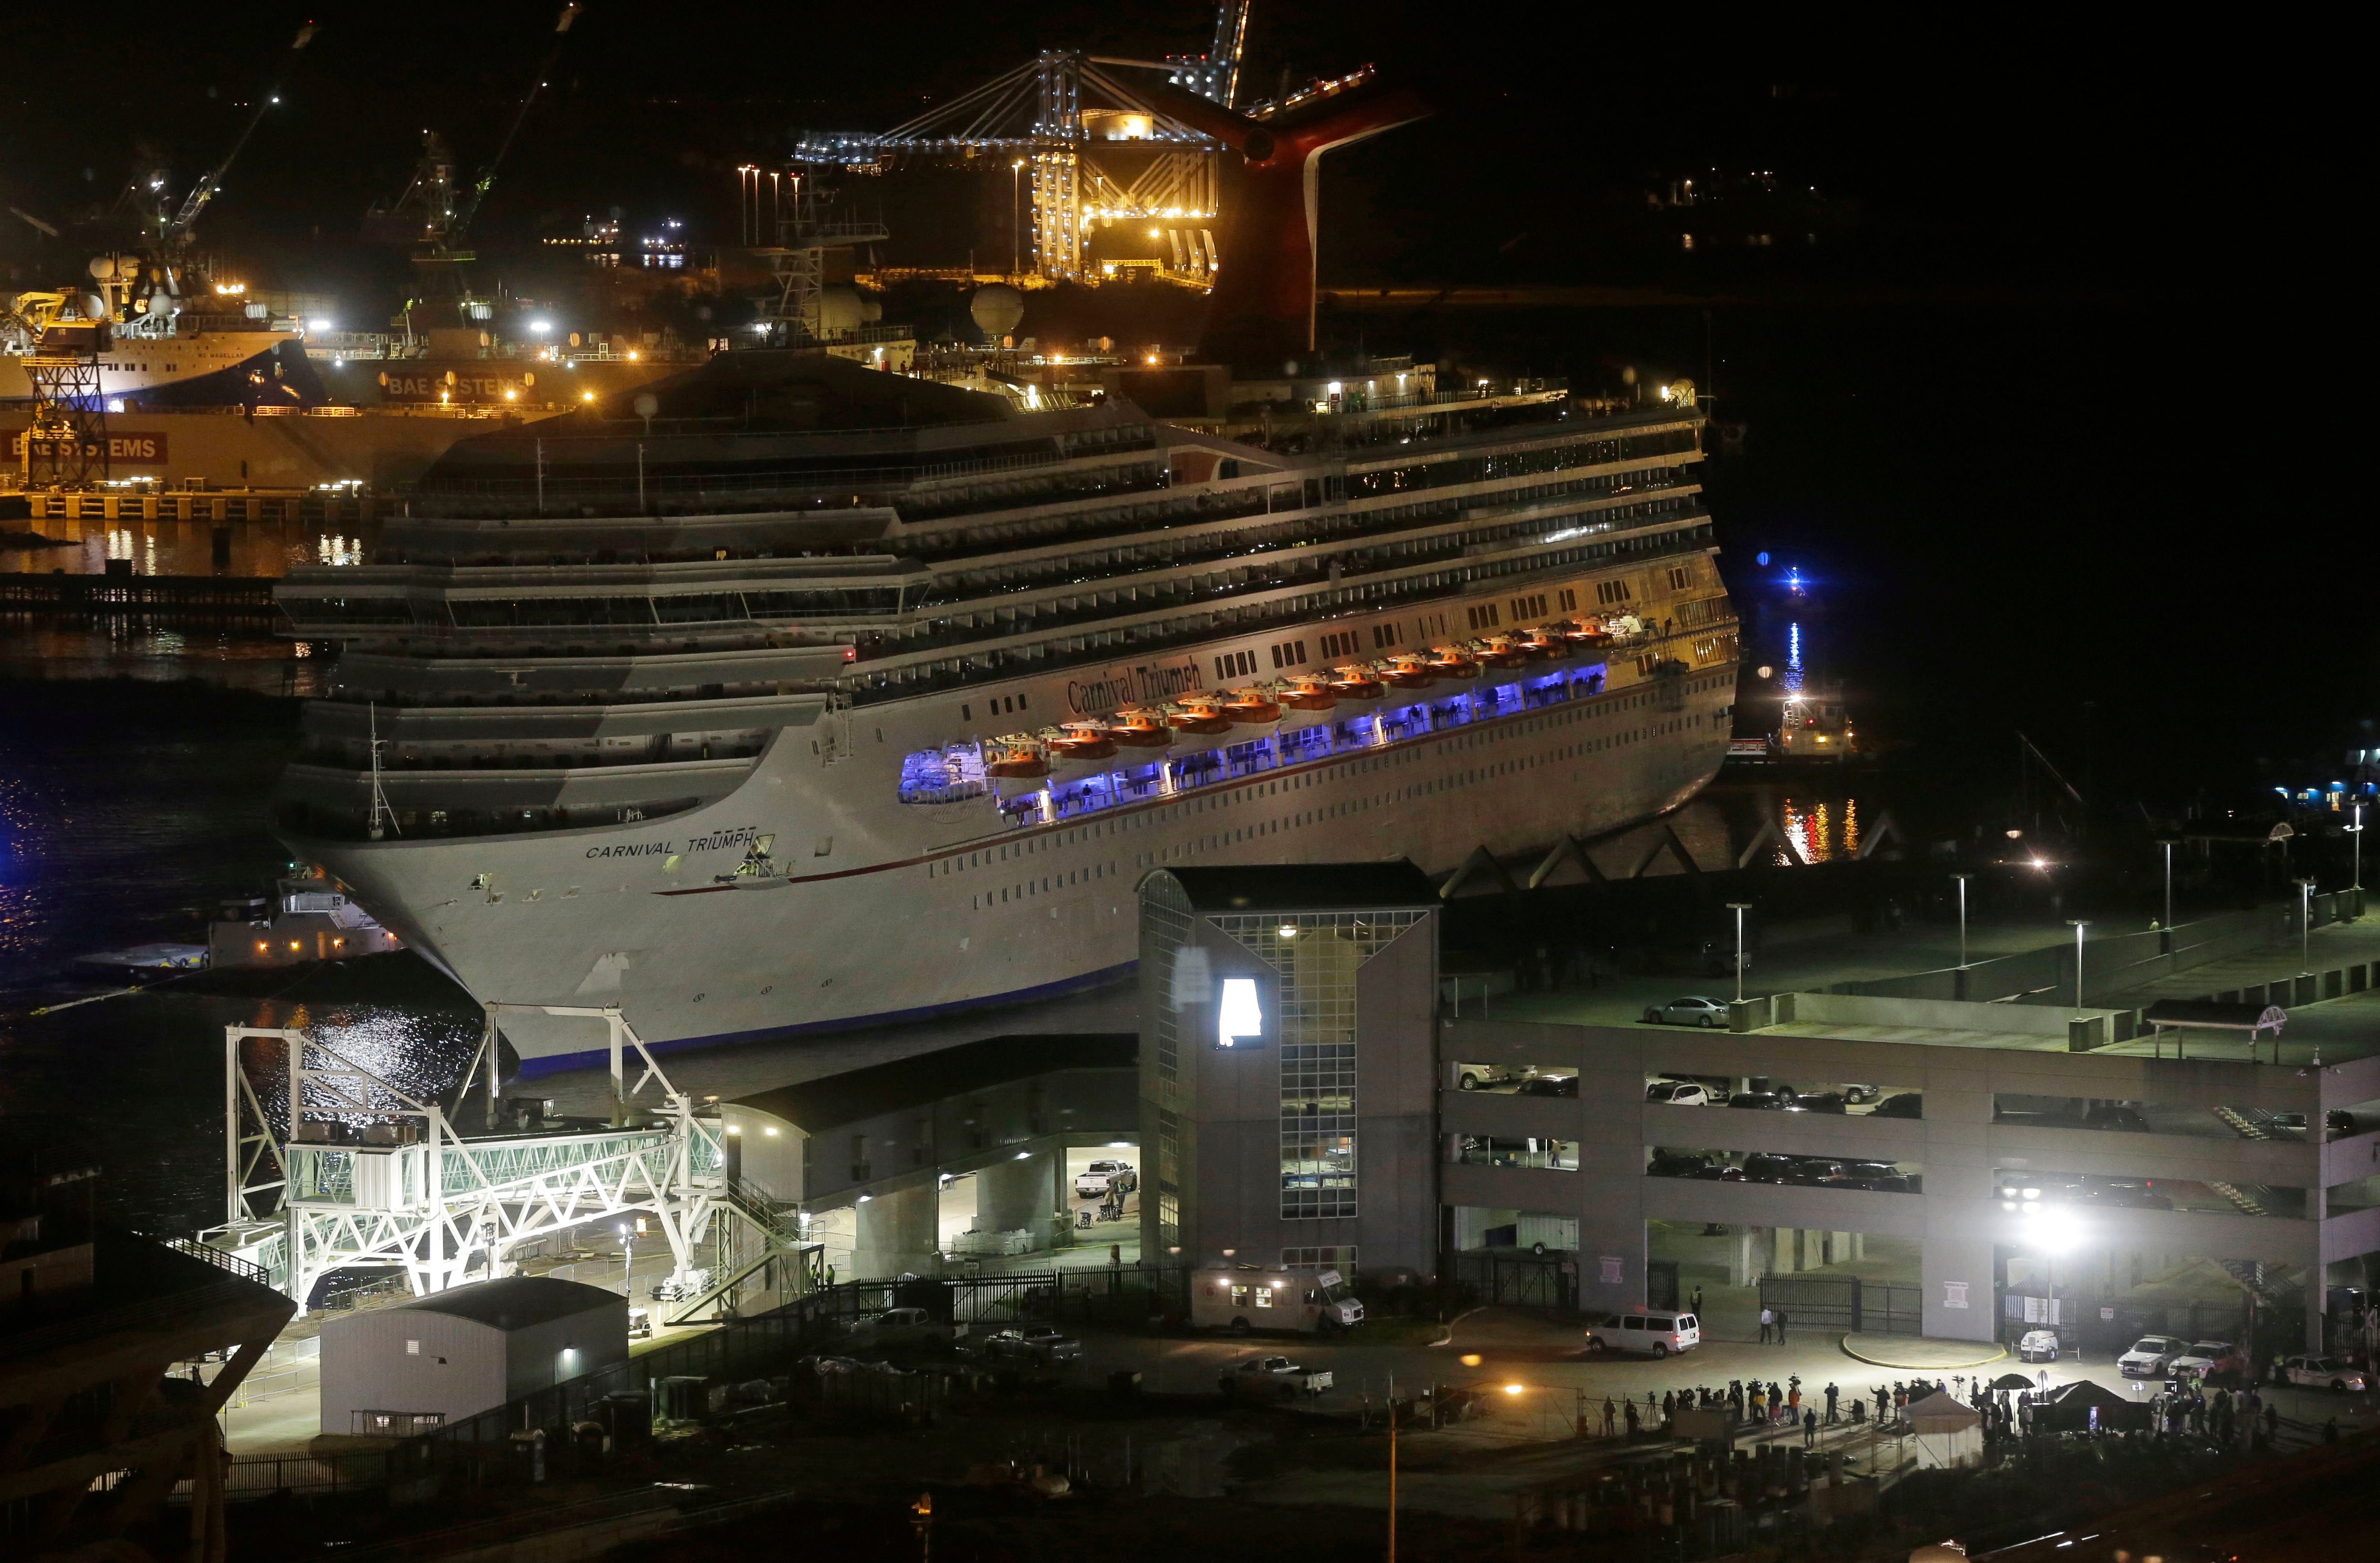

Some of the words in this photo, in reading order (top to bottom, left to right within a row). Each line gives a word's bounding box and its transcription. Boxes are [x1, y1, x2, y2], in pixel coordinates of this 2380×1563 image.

[389, 378, 429, 395] BAE
[1068, 666, 1136, 714] Carnival
[1136, 654, 1203, 700] Triumph
[586, 841, 674, 859] CARNIVAL
[687, 831, 754, 853] TRIUMPH
